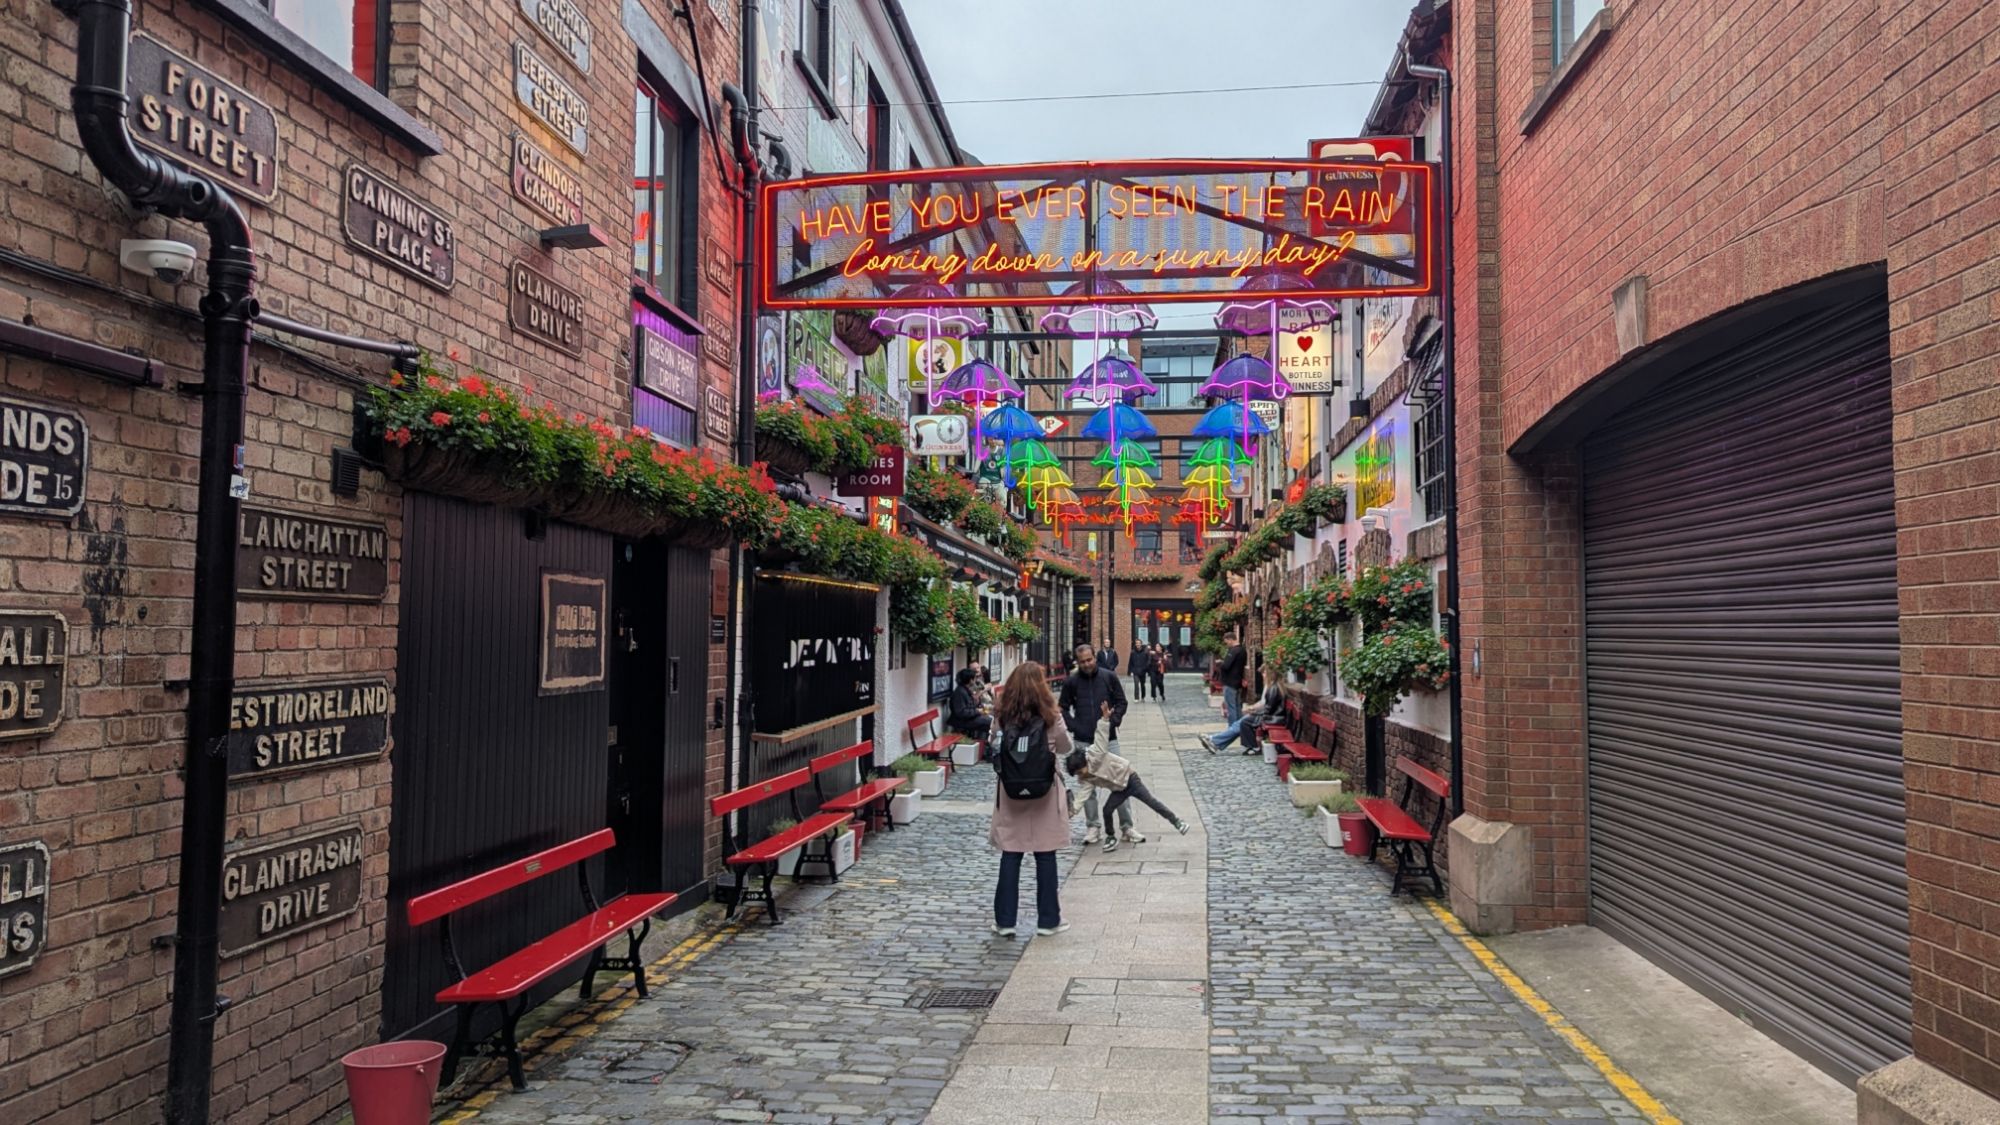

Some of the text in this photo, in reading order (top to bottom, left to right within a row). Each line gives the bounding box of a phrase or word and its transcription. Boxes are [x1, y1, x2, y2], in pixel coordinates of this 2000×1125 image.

[537, 1, 577, 57] COURT
[166, 61, 250, 135] FORT
[520, 48, 587, 126] BERESFORD
[533, 86, 576, 141] STREET
[141, 94, 267, 185] STREET
[1325, 171, 1373, 181] GUINNESS
[351, 172, 428, 237] CANNING
[802, 185, 1393, 240] HAVE YOU EVER SEEN THE RAIN
[376, 221, 432, 272] PLACE
[844, 231, 1355, 284] Coming down on a sunny day?
[530, 304, 571, 343] DRIVE
[1281, 309, 1330, 319] MORTON'S
[1289, 322, 1321, 333] RED
[649, 337, 695, 378] GIBSON PARK
[707, 334, 731, 363] STREET
[1280, 356, 1331, 367] HEART
[659, 366, 680, 395] DRIVE
[1288, 371, 1322, 379] BOTTLED
[708, 392, 730, 416] KELLS
[708, 411, 730, 436] STREET
[3, 407, 75, 455] NDS
[0, 459, 74, 503] DE 15
[850, 474, 891, 486] ROOM
[262, 556, 352, 590] STREET
[0, 626, 64, 665] ALL
[0, 679, 45, 720] DE
[231, 686, 387, 729] ESTMORELAND
[256, 726, 346, 767] STREET
[1, 858, 44, 902] LL
[260, 882, 331, 934] DRIVE
